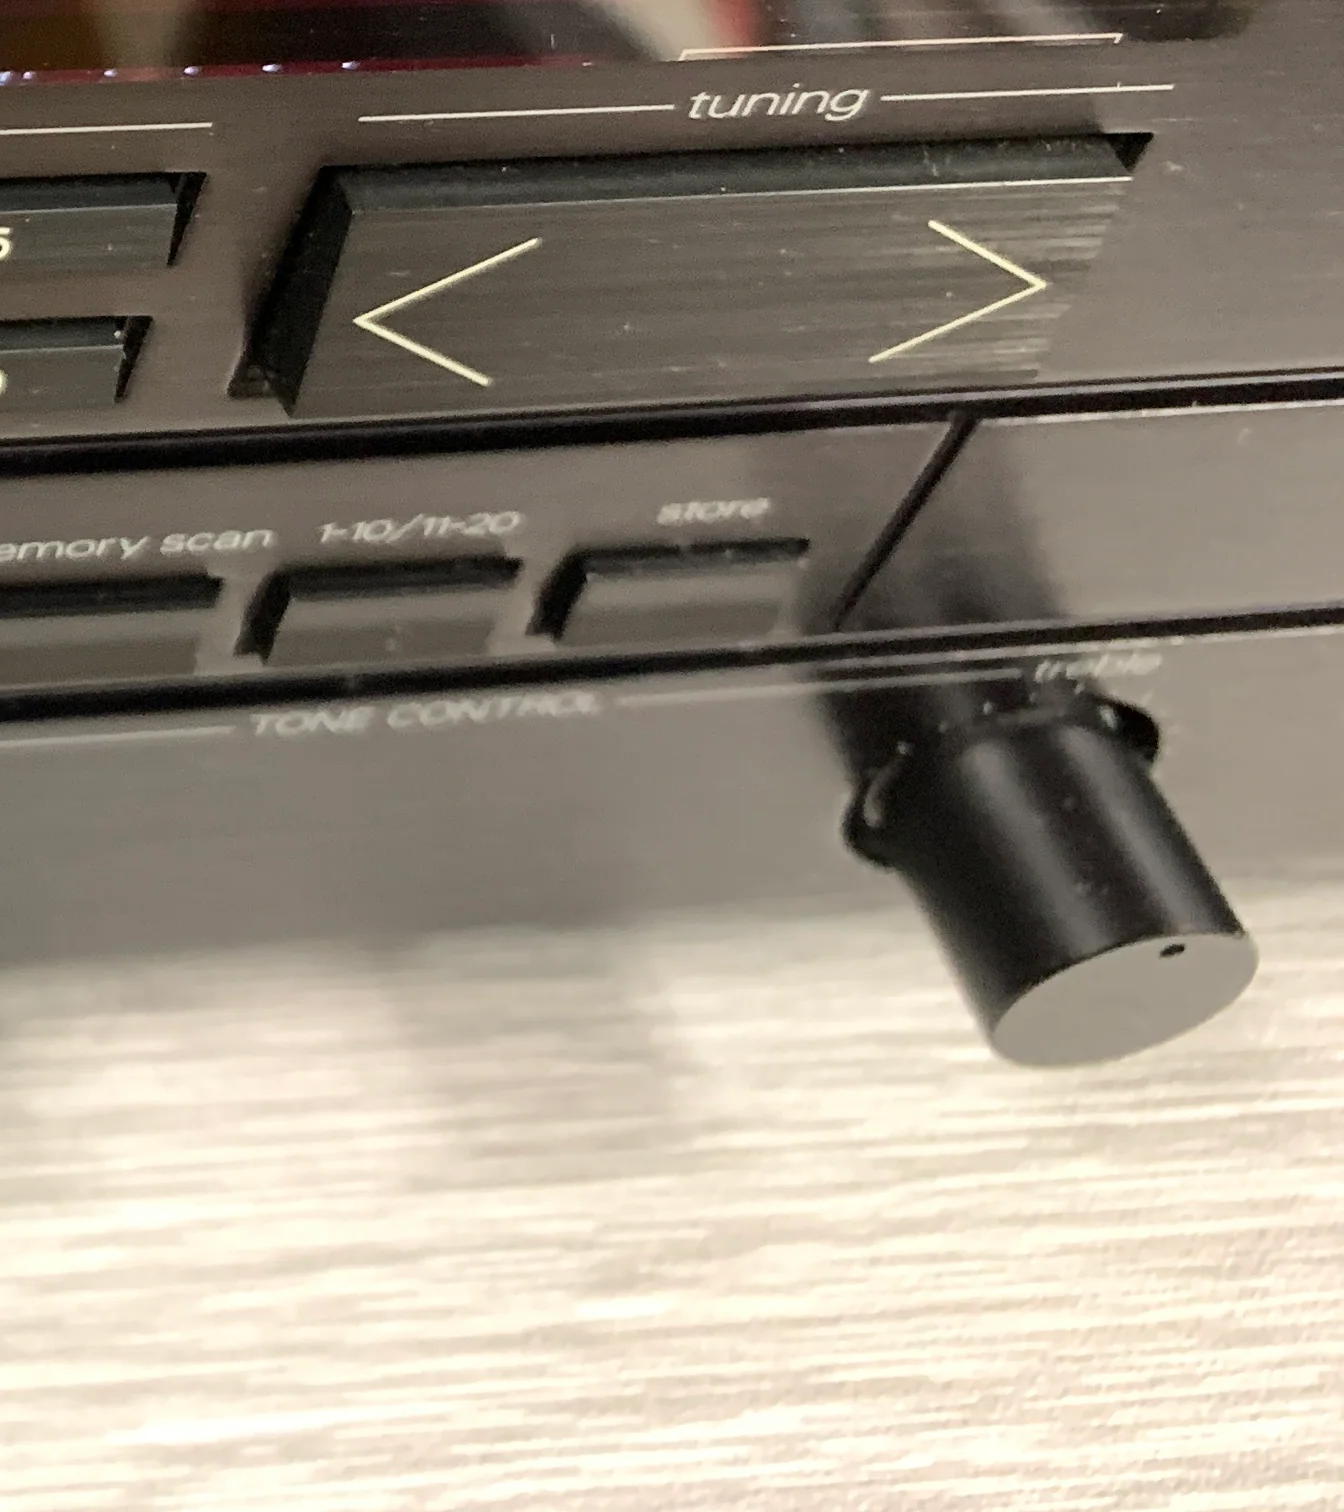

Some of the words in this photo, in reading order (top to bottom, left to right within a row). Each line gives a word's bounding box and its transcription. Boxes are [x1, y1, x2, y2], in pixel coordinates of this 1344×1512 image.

[688, 85, 870, 121] tuning
[319, 509, 525, 544] 1-10/11-20
[656, 497, 771, 526] store
[159, 526, 276, 555] scan
[251, 704, 376, 736] TONE
[387, 690, 601, 729] CONTROL
